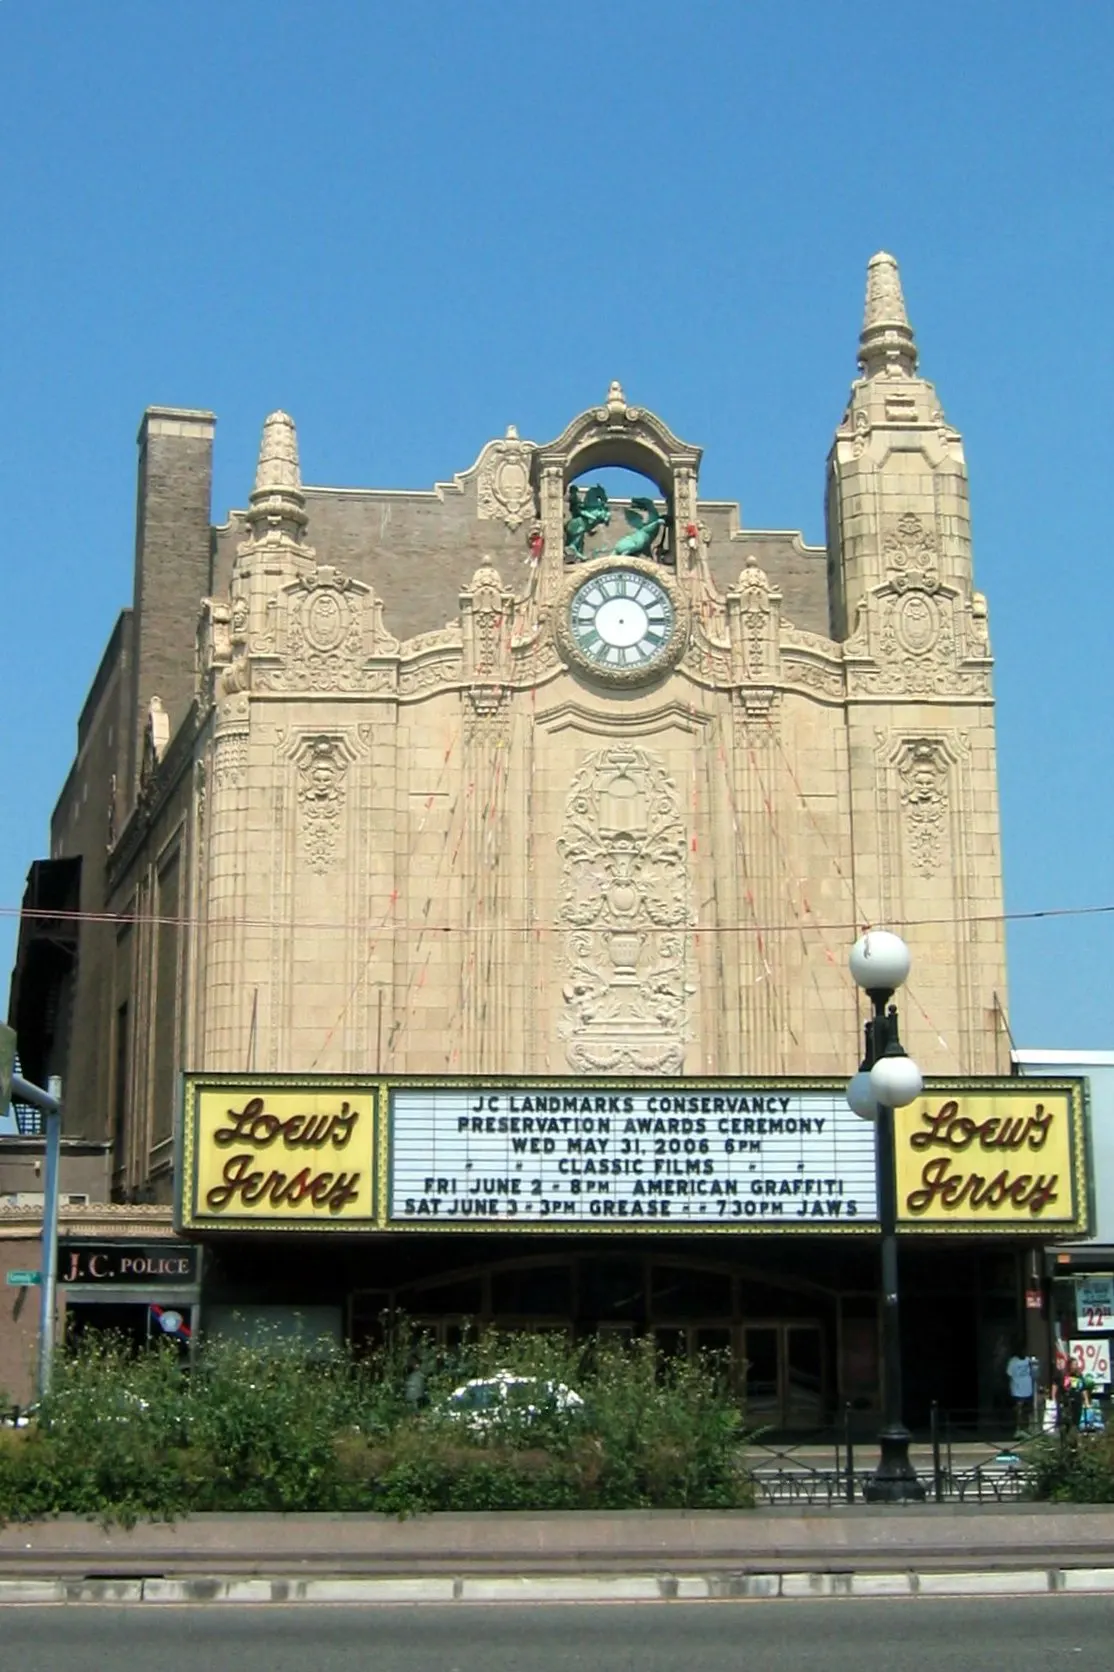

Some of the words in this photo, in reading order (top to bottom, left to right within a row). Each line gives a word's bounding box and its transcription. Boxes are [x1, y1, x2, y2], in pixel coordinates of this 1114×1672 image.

[472, 1096, 499, 1113] JC
[509, 1096, 634, 1113] LANDMARKS
[647, 1097, 790, 1114] CONSERVANCY
[214, 1098, 359, 1147] Loew's
[457, 1116, 610, 1134] PRESERVATION
[624, 1118, 706, 1135] AWARDS
[718, 1118, 825, 1135] CEREMONY
[911, 1101, 1053, 1150] Loew's
[512, 1137, 555, 1154] WED
[567, 1138, 608, 1155] MAY
[621, 1138, 646, 1156] 31,
[654, 1138, 709, 1155] 2006
[724, 1138, 762, 1155] 6PM
[558, 1158, 643, 1175] CLASSIC
[655, 1159, 714, 1176] FILMS
[206, 1154, 360, 1213] Jersey
[424, 1178, 457, 1195] FRI
[469, 1178, 521, 1195] JUNE
[531, 1179, 542, 1195] 2
[632, 1179, 738, 1196] AMERICAN
[750, 1179, 844, 1196] GRAFFITI
[906, 1157, 1058, 1217] Jersey
[404, 1198, 442, 1215] SAT
[447, 1199, 499, 1216] JUNE
[540, 1200, 576, 1216] 3PM
[589, 1200, 671, 1217] GREASE
[796, 1200, 858, 1217] JAWS
[120, 1258, 189, 1275] POLICE
